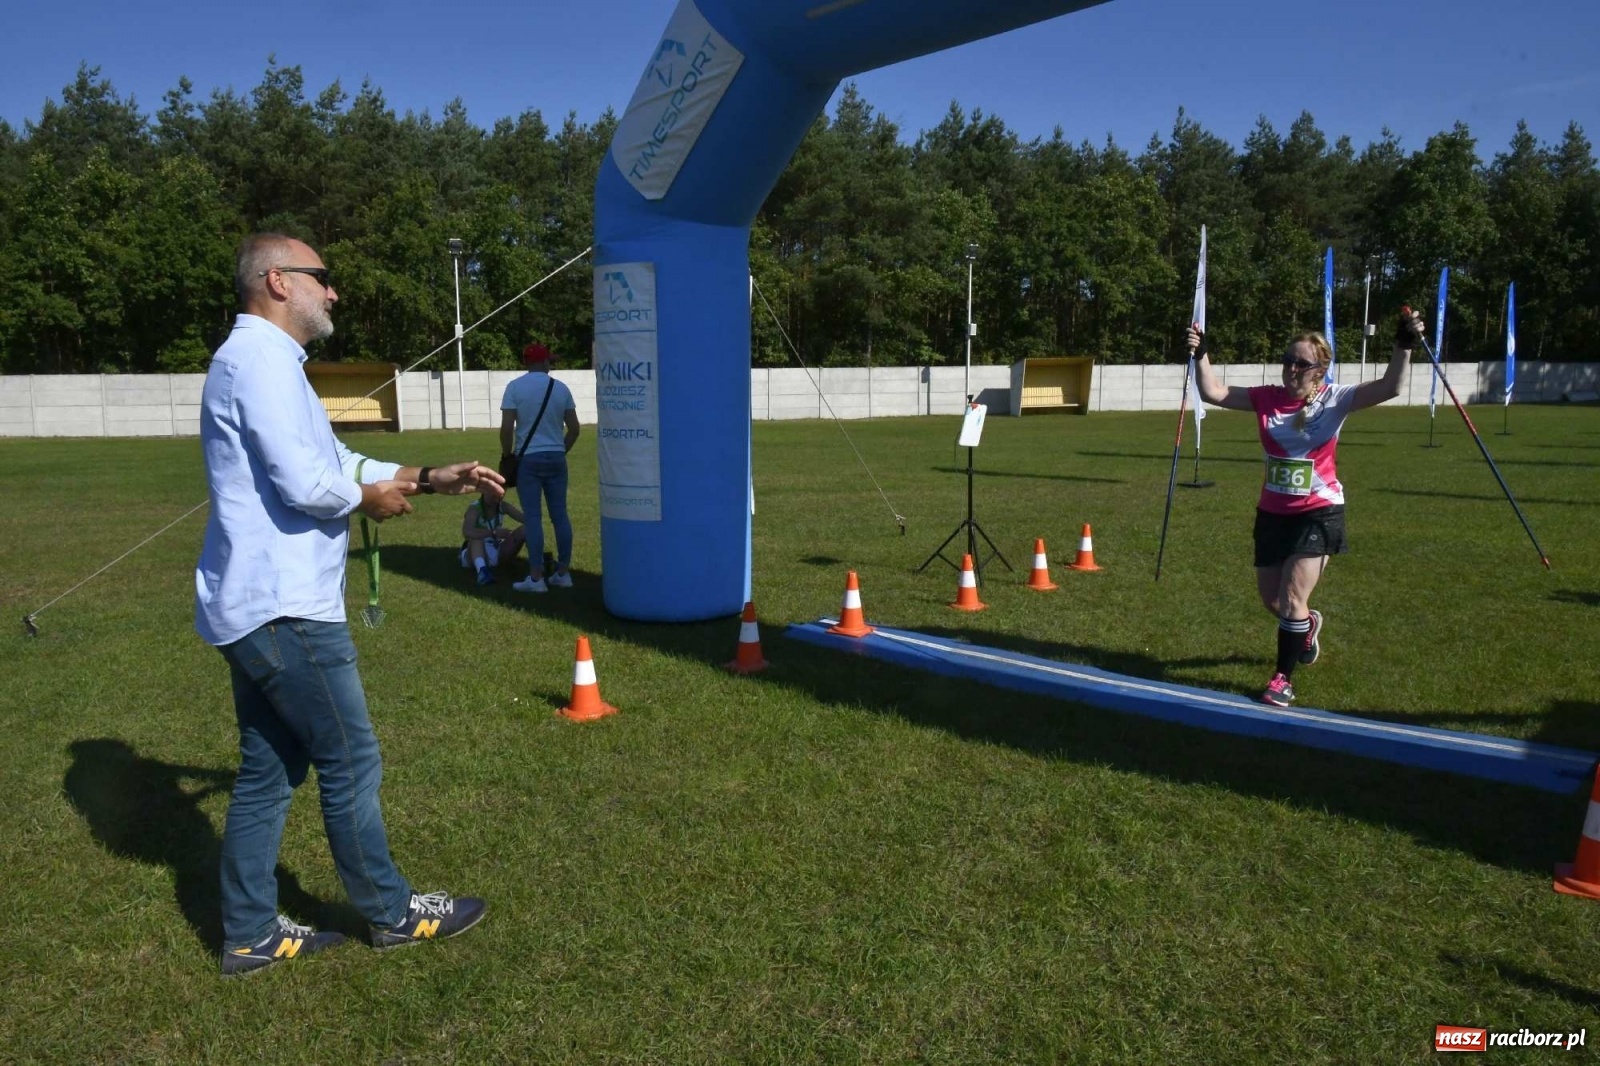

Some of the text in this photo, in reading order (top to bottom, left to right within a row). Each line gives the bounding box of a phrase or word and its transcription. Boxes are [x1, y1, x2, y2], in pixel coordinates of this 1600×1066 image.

[630, 33, 717, 180] TIMESPORT
[1271, 466, 1305, 486] 136
[413, 919, 440, 937] N
[275, 938, 303, 957] N
